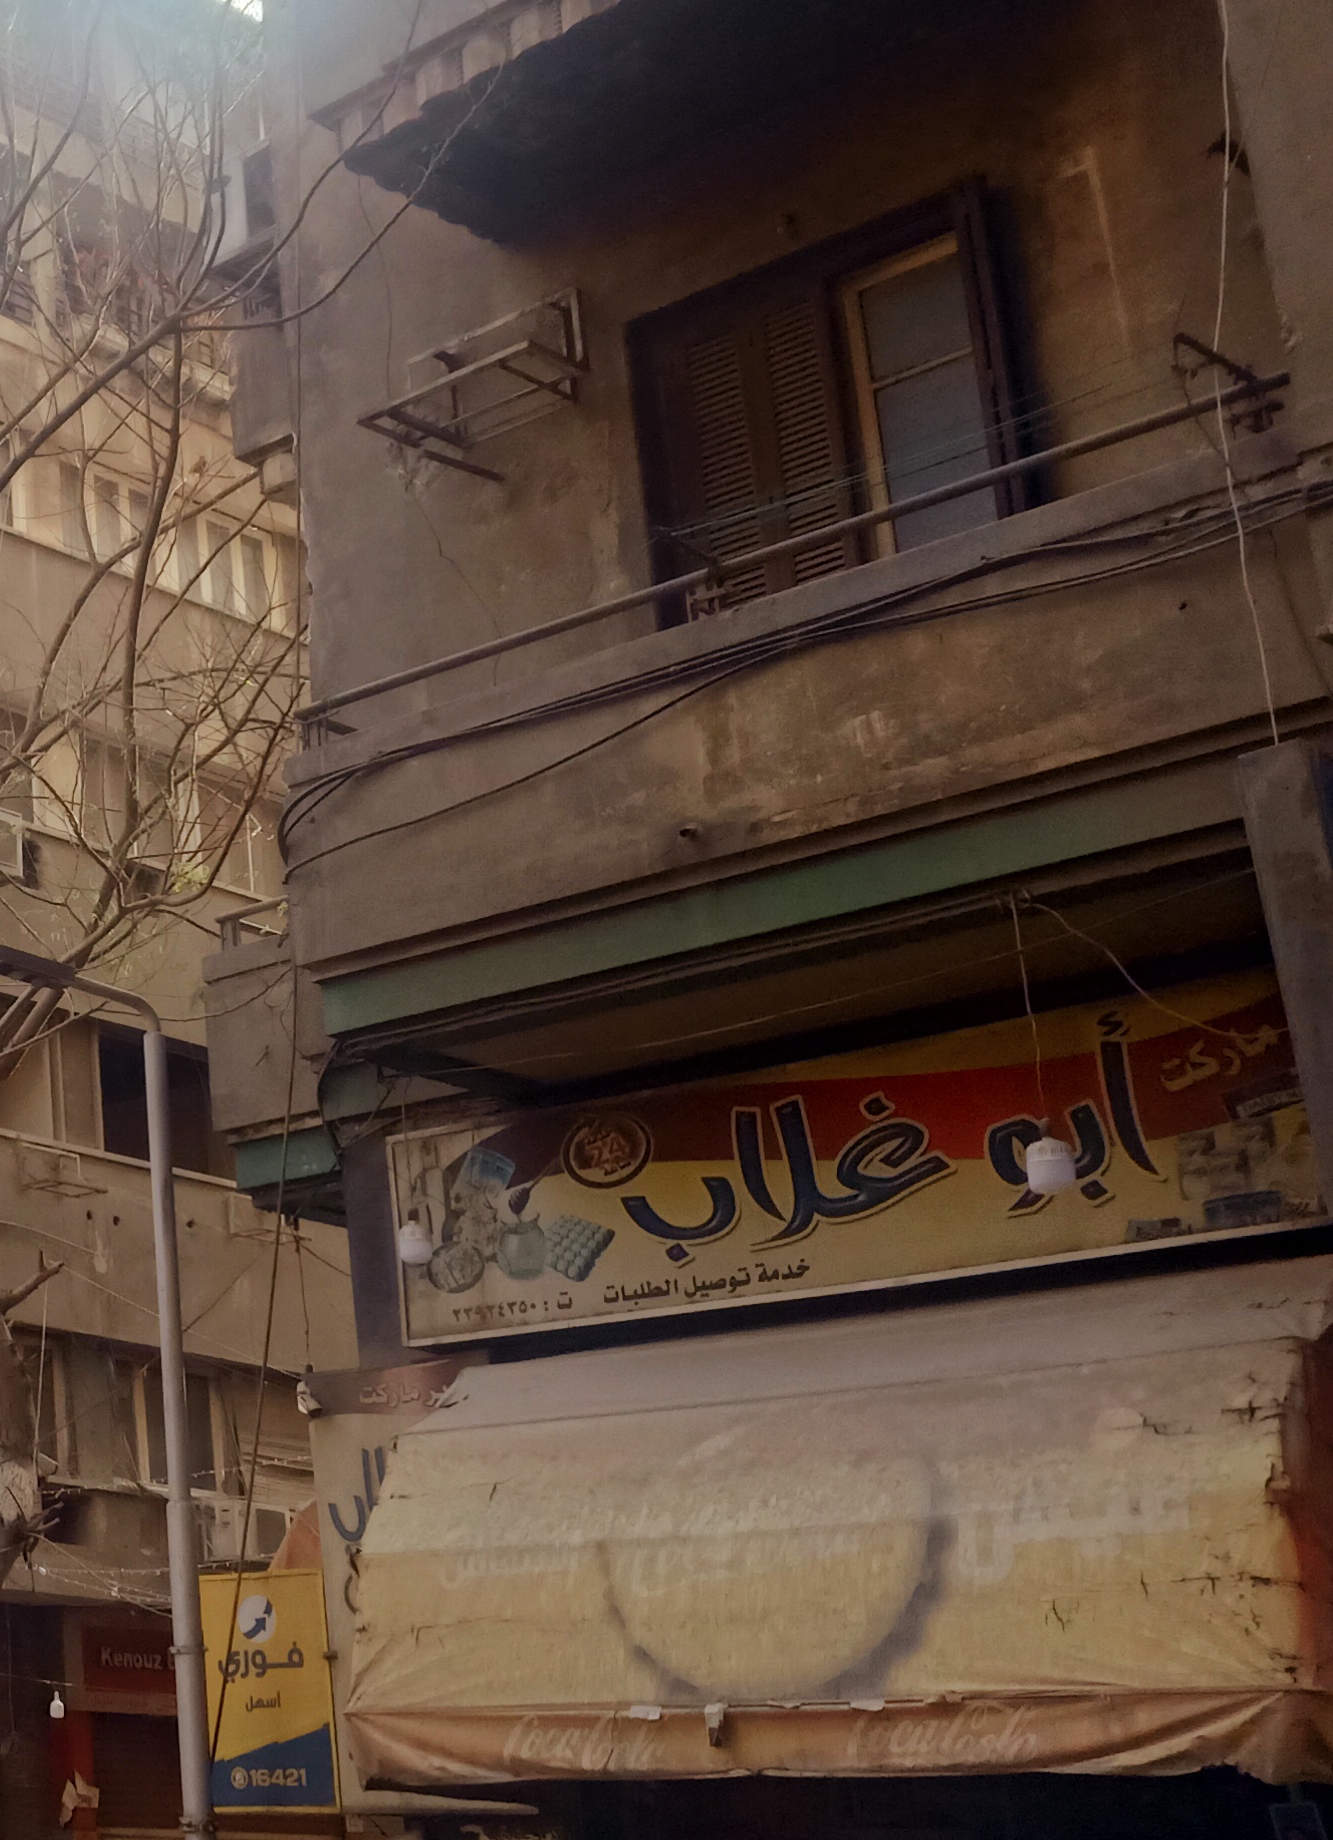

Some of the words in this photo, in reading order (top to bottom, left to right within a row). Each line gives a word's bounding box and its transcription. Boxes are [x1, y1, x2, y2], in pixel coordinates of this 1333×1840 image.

[984, 1011, 1166, 1217] أبو
[621, 1091, 957, 1266] غلاب
[683, 1267, 752, 1299] توصيل
[756, 1257, 811, 1284] خدمة
[602, 1278, 679, 1306] الطلبات
[359, 1382, 421, 1408] ماركت
[100, 1646, 163, 1670] Kenouz
[217, 1641, 305, 1684] فوري
[250, 1767, 307, 1787] 16421
